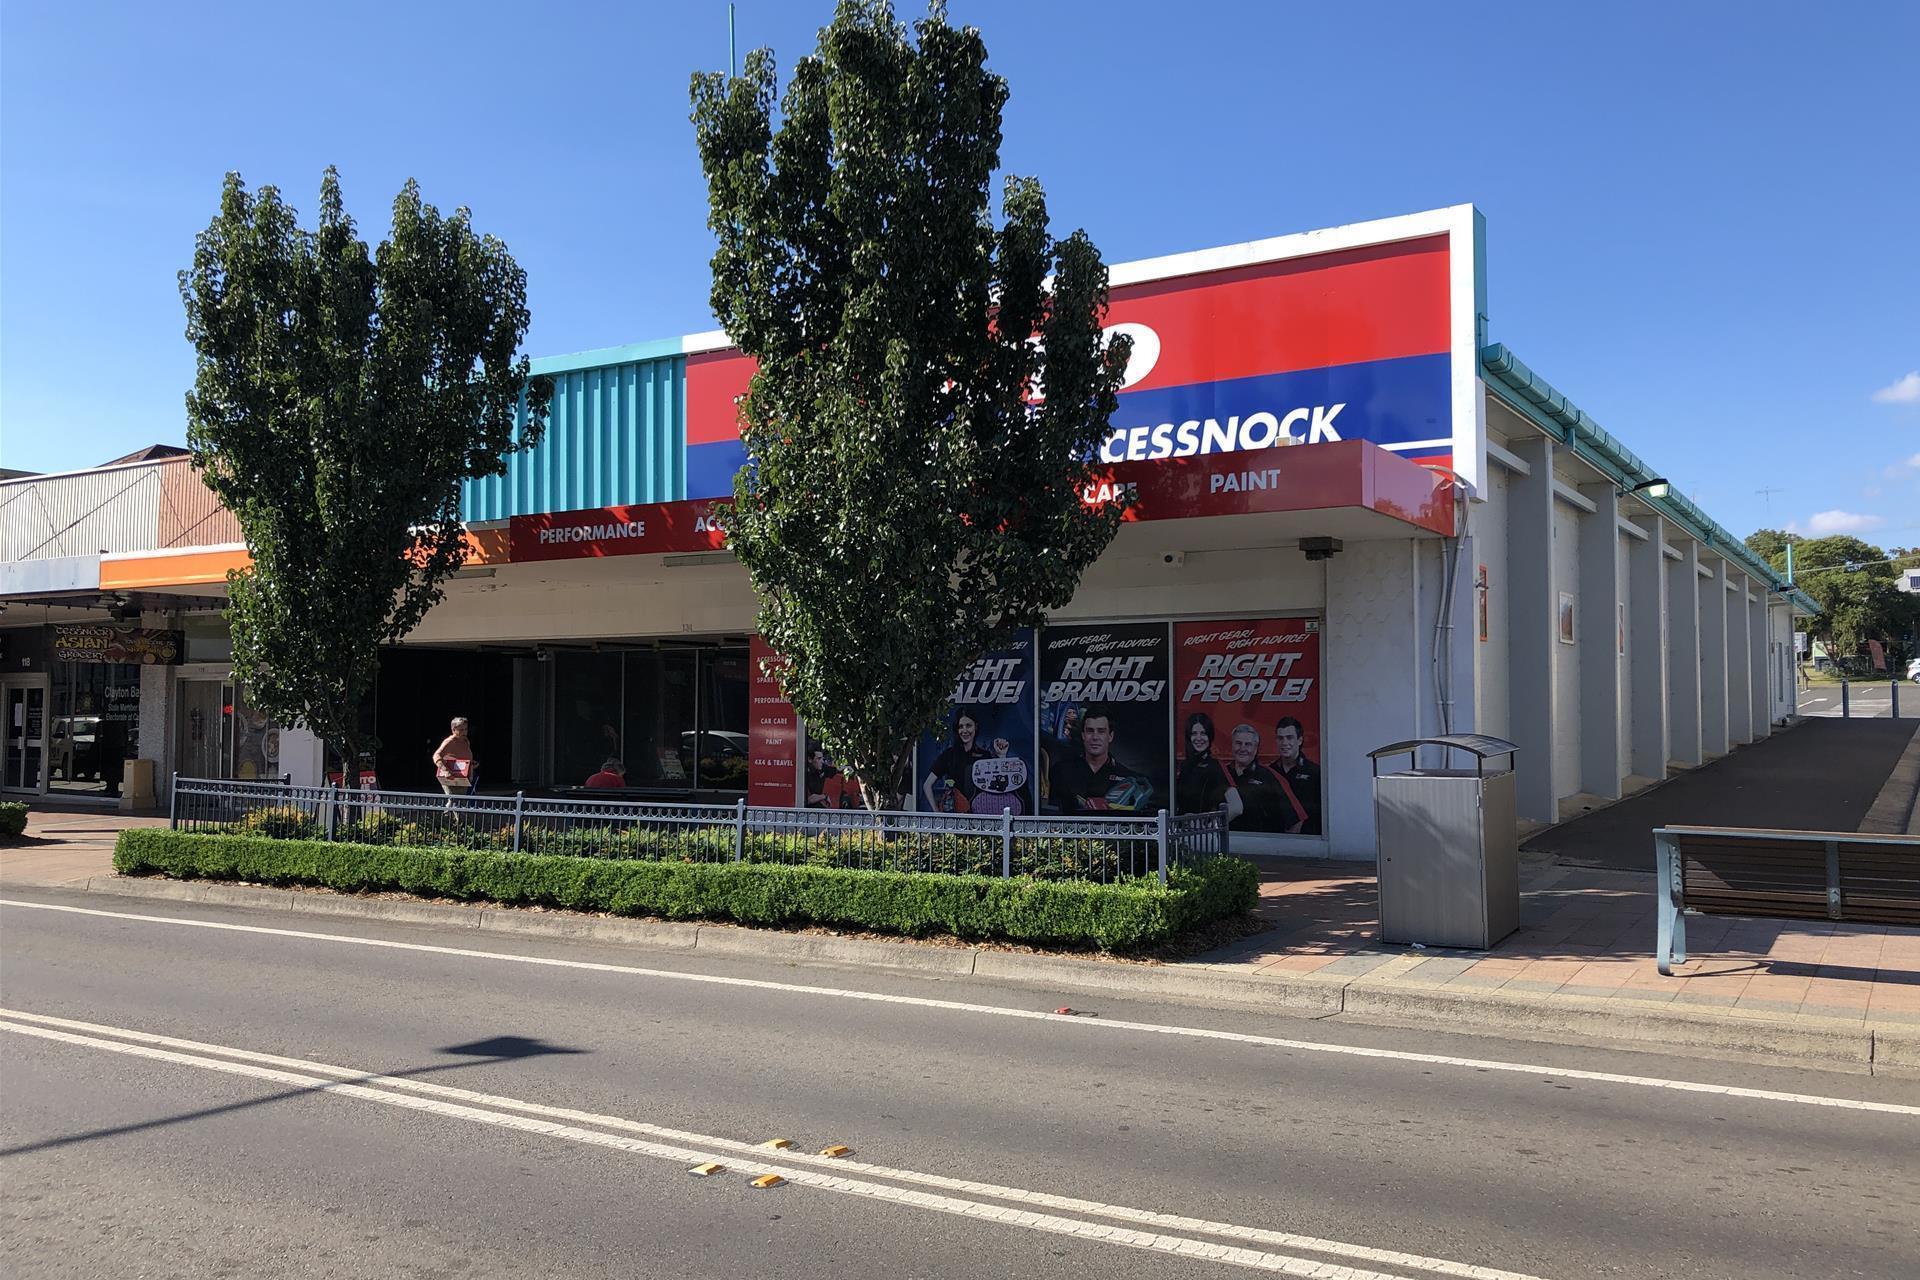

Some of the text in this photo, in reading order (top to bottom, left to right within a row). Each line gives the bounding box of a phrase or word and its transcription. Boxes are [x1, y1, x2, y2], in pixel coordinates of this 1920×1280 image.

[1101, 403, 1347, 464] CESSNOCK
[1210, 469, 1281, 494] PAINT
[540, 521, 645, 544] PERFORMANCE
[55, 636, 111, 649] ASIAN
[1048, 633, 1112, 650] RIGHT GEAR!
[1085, 638, 1162, 654] RIGHT ADVICE!
[1183, 629, 1256, 646] RIGHT GEAR!
[1226, 633, 1311, 650] RIGHT ADVICE!
[58, 649, 104, 660] GROCERY
[1060, 655, 1155, 680] RIGHT
[1197, 652, 1303, 678] RIGHT
[756, 676, 774, 684] SPARE
[104, 686, 140, 700] Clayton Ba
[945, 681, 1026, 704] ALUE!
[1044, 680, 1167, 702] BRANDS!
[1182, 678, 1314, 703] PEOPLE!
[773, 759, 794, 767] TRAVEL
